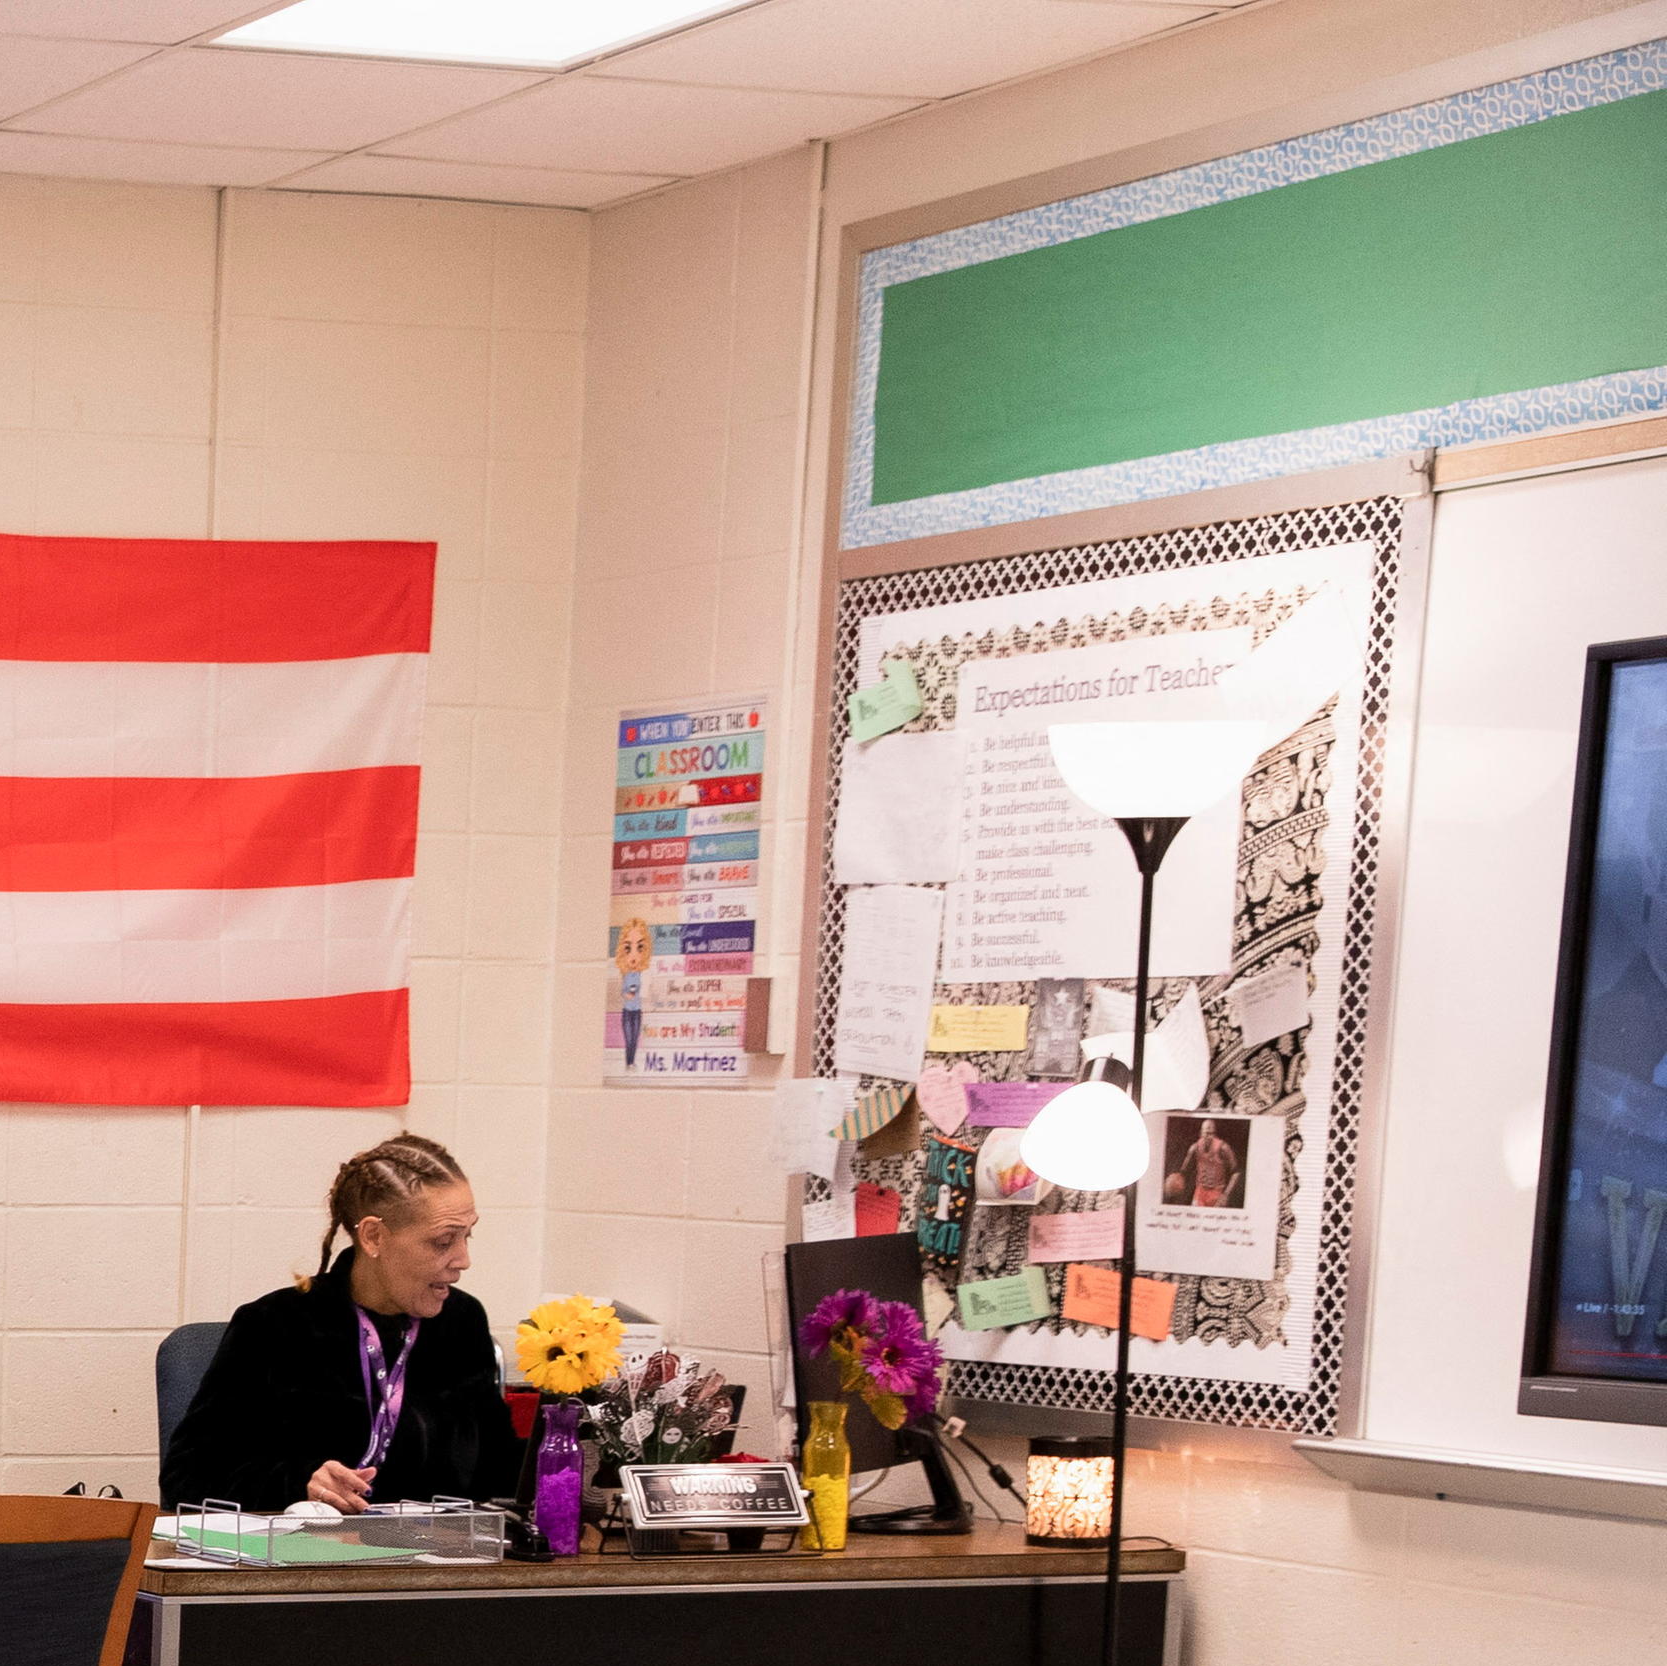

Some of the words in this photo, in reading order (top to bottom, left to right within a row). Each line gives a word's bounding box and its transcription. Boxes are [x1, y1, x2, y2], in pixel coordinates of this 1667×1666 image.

[974, 675, 1101, 717] Expectations
[1107, 668, 1139, 697] for
[1144, 658, 1236, 693] Teache
[691, 716, 721, 734] ENTER
[726, 713, 744, 729] THIS
[634, 740, 749, 778] CLASSROOM
[672, 1051, 737, 1072] Martinez
[669, 1475, 757, 1496] WARNING
[651, 1500, 708, 1512] NEEDS
[720, 1498, 788, 1510] COFFEE
